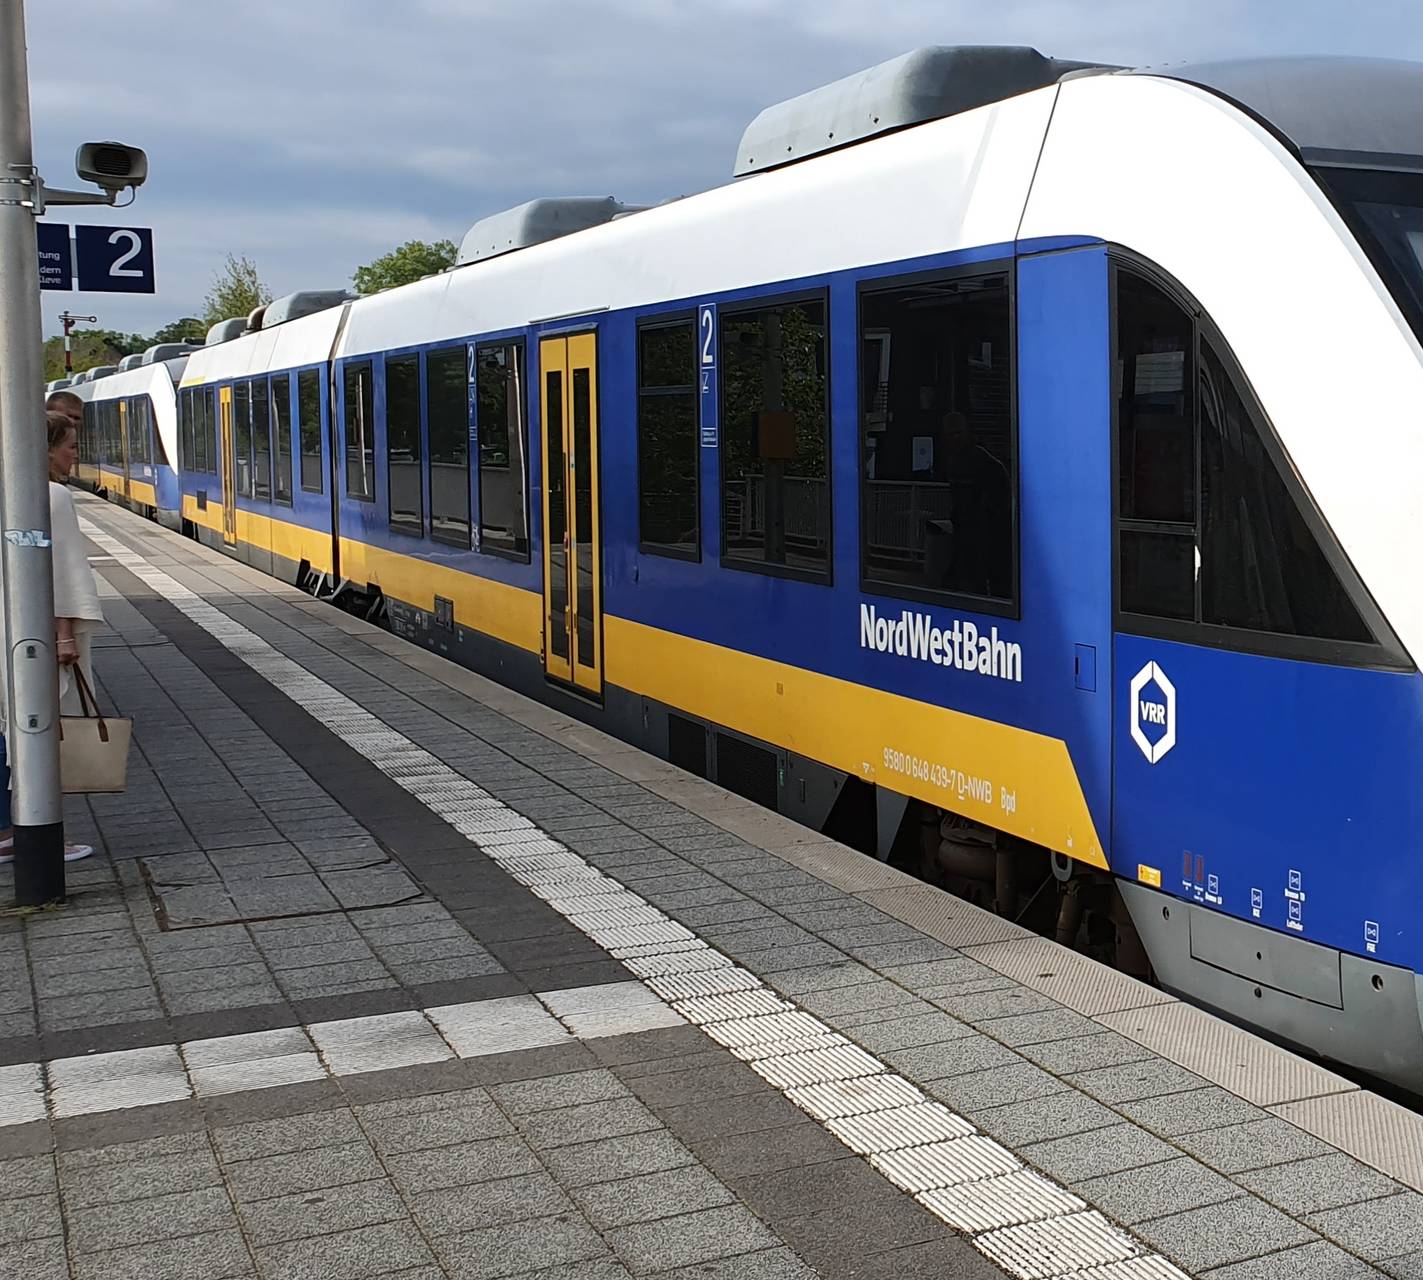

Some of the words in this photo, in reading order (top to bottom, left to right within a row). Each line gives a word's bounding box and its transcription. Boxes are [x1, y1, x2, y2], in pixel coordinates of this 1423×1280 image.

[39, 251, 60, 261] tung
[40, 266, 61, 274] dern
[107, 229, 144, 277] 2
[702, 309, 714, 364] 2
[467, 345, 475, 383] 2
[860, 603, 1022, 682] NordWestBahn
[1140, 700, 1166, 725] VRR
